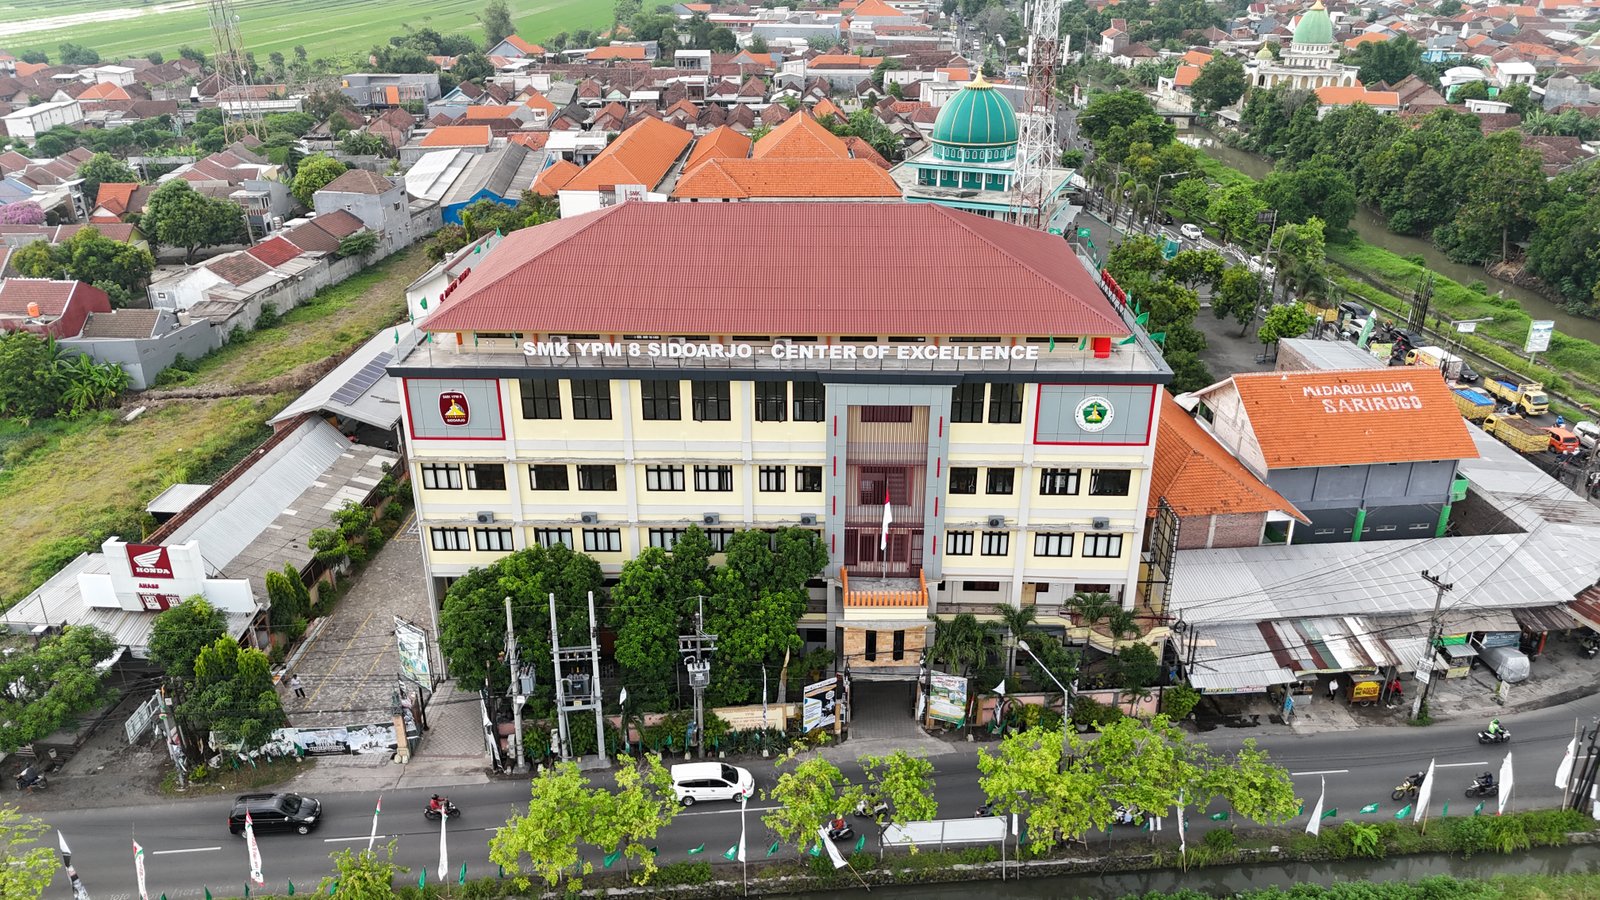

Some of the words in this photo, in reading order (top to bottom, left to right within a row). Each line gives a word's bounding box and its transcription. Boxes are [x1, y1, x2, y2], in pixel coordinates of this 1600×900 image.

[523, 342, 571, 357] SMK
[575, 342, 622, 357] YPM
[628, 342, 641, 357] 8
[647, 343, 752, 358] SIDOARJO
[771, 344, 857, 359] CENTER
[862, 345, 890, 359] OF
[897, 345, 1039, 360] EXCELLENCE
[1322, 396, 1422, 413] SARIROGO
